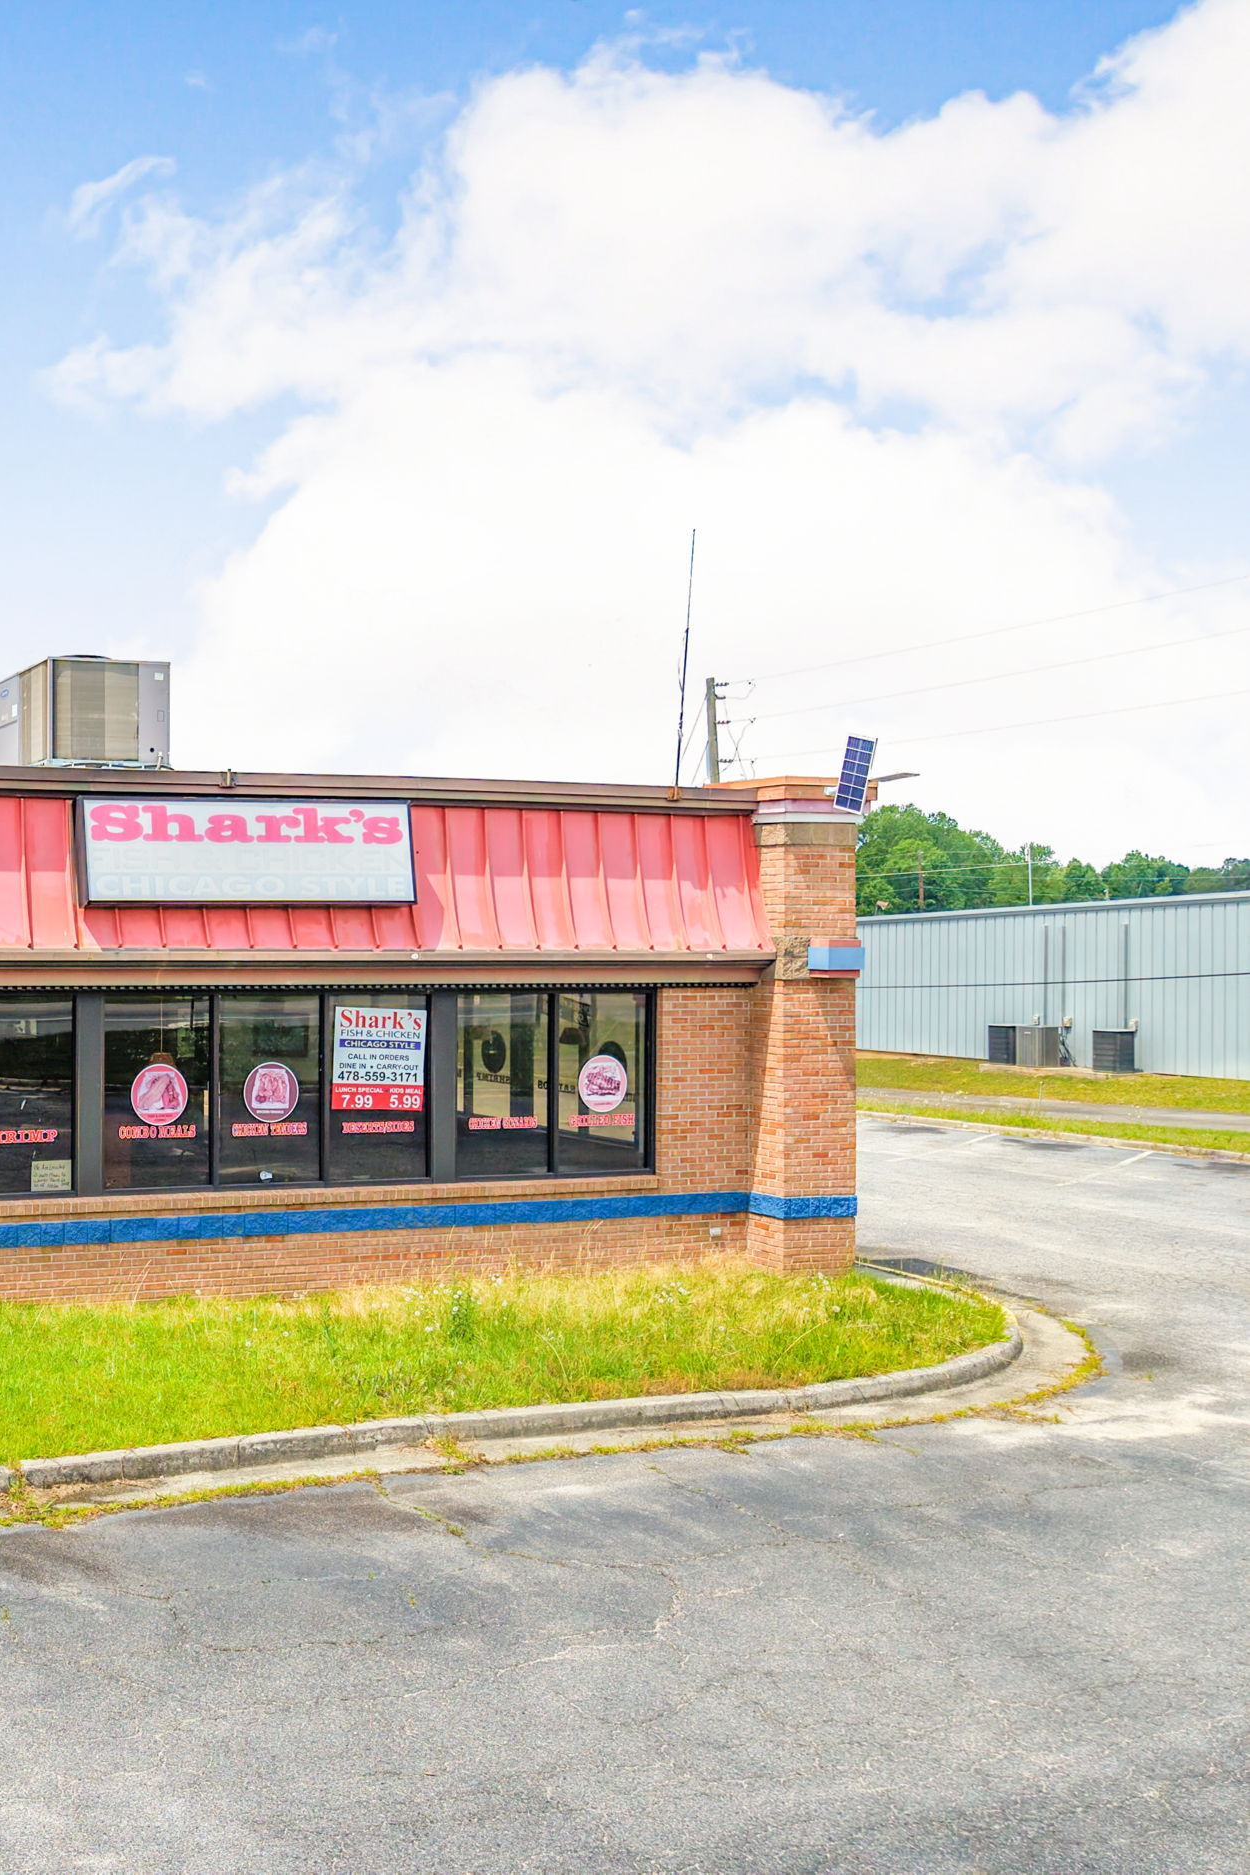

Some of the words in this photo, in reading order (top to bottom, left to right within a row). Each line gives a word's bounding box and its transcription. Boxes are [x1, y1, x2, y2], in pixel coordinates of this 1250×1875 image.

[89, 803, 405, 845] Shark's
[90, 847, 180, 870] FISH
[194, 848, 222, 870] &
[237, 848, 409, 873] CHICKEN
[95, 874, 286, 897] CHICAGO
[300, 876, 406, 897] STYLE
[340, 1008, 422, 1031] Shark's
[340, 1028, 364, 1037] FISH
[366, 1030, 374, 1038] &
[376, 1030, 421, 1040] CHICKEN
[344, 1040, 387, 1048] CHICAGO
[389, 1041, 416, 1049] STYLE
[378, 1054, 410, 1062] ORDERS
[376, 1063, 419, 1071] CARRY-OUT
[337, 1070, 418, 1083] 478-559-3171
[341, 1094, 373, 1108] 7.99
[389, 1094, 421, 1109] 5.99
[468, 1117, 502, 1130] CHICKEN
[569, 1114, 611, 1127] GRILLED
[611, 1113, 635, 1126] FISH
[118, 1125, 157, 1139] COMBO
[158, 1124, 196, 1139] MEALS
[232, 1123, 269, 1137] CHICKEN
[270, 1121, 308, 1136] TENDERS
